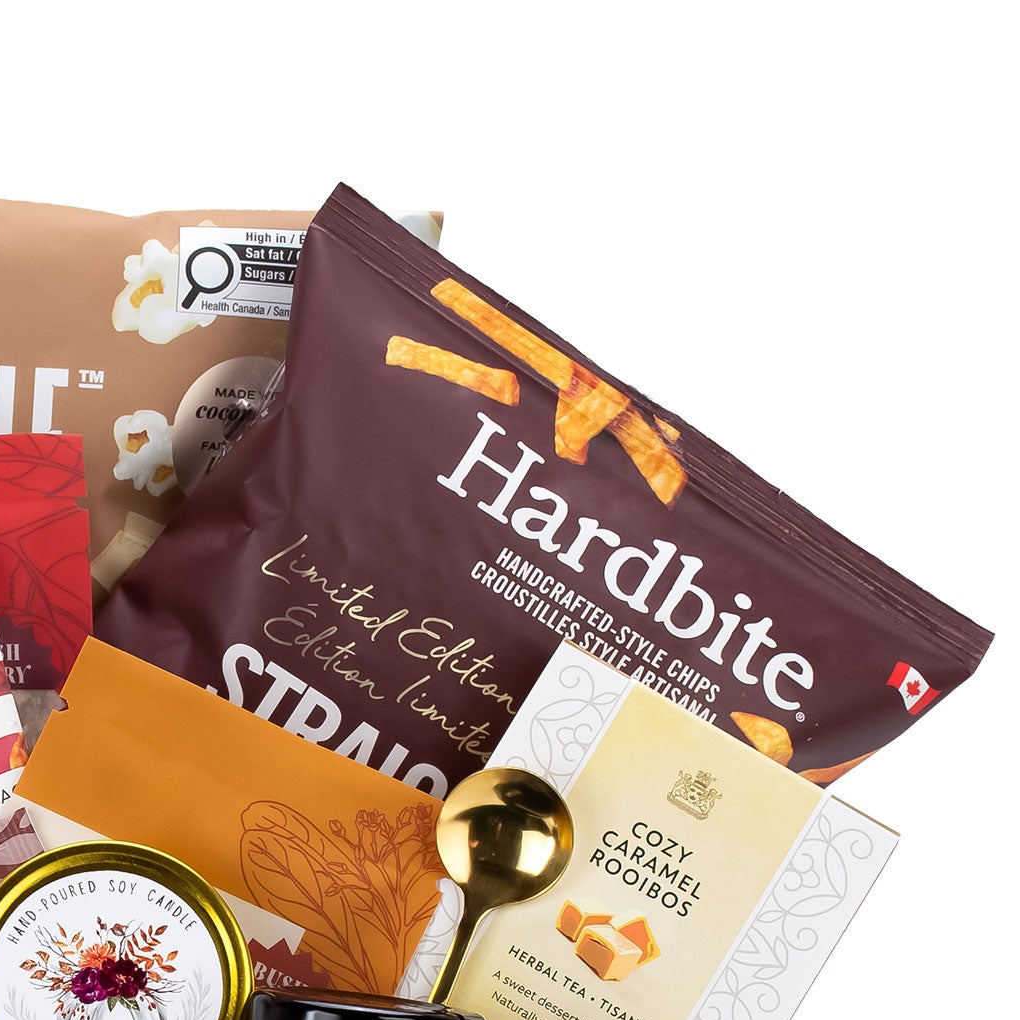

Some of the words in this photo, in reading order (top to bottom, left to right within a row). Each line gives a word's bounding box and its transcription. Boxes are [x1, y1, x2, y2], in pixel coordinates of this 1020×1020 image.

[245, 232, 272, 244] High
[276, 233, 286, 243] in
[245, 247, 265, 259] Sat
[268, 248, 284, 261] fat
[244, 267, 285, 281] Sugars
[201, 301, 230, 312] Health
[232, 303, 265, 315] Canada
[273, 306, 290, 317] San
[215, 387, 256, 400] MADE
[436, 412, 815, 713] Hardbite
[261, 533, 409, 641] Limited
[397, 617, 518, 716] Edition
[470, 561, 580, 641] CROUSTILLES
[579, 632, 632, 673] STYLE
[495, 547, 668, 669] HANDCRAFTED-STYLE
[666, 659, 721, 703] CHIPS
[263, 602, 385, 700] Édition
[602, 831, 702, 900] CARAMEL
[631, 822, 694, 863] COZY
[6, 880, 97, 945] HAND-POURED
[108, 879, 138, 896] SOY
[147, 888, 198, 932] CANDLE
[589, 849, 692, 917] ROOIBOS
[492, 970, 501, 981] A
[502, 976, 537, 1001] sweet
[508, 945, 558, 983] HERBAL
[562, 975, 586, 999] TEA
